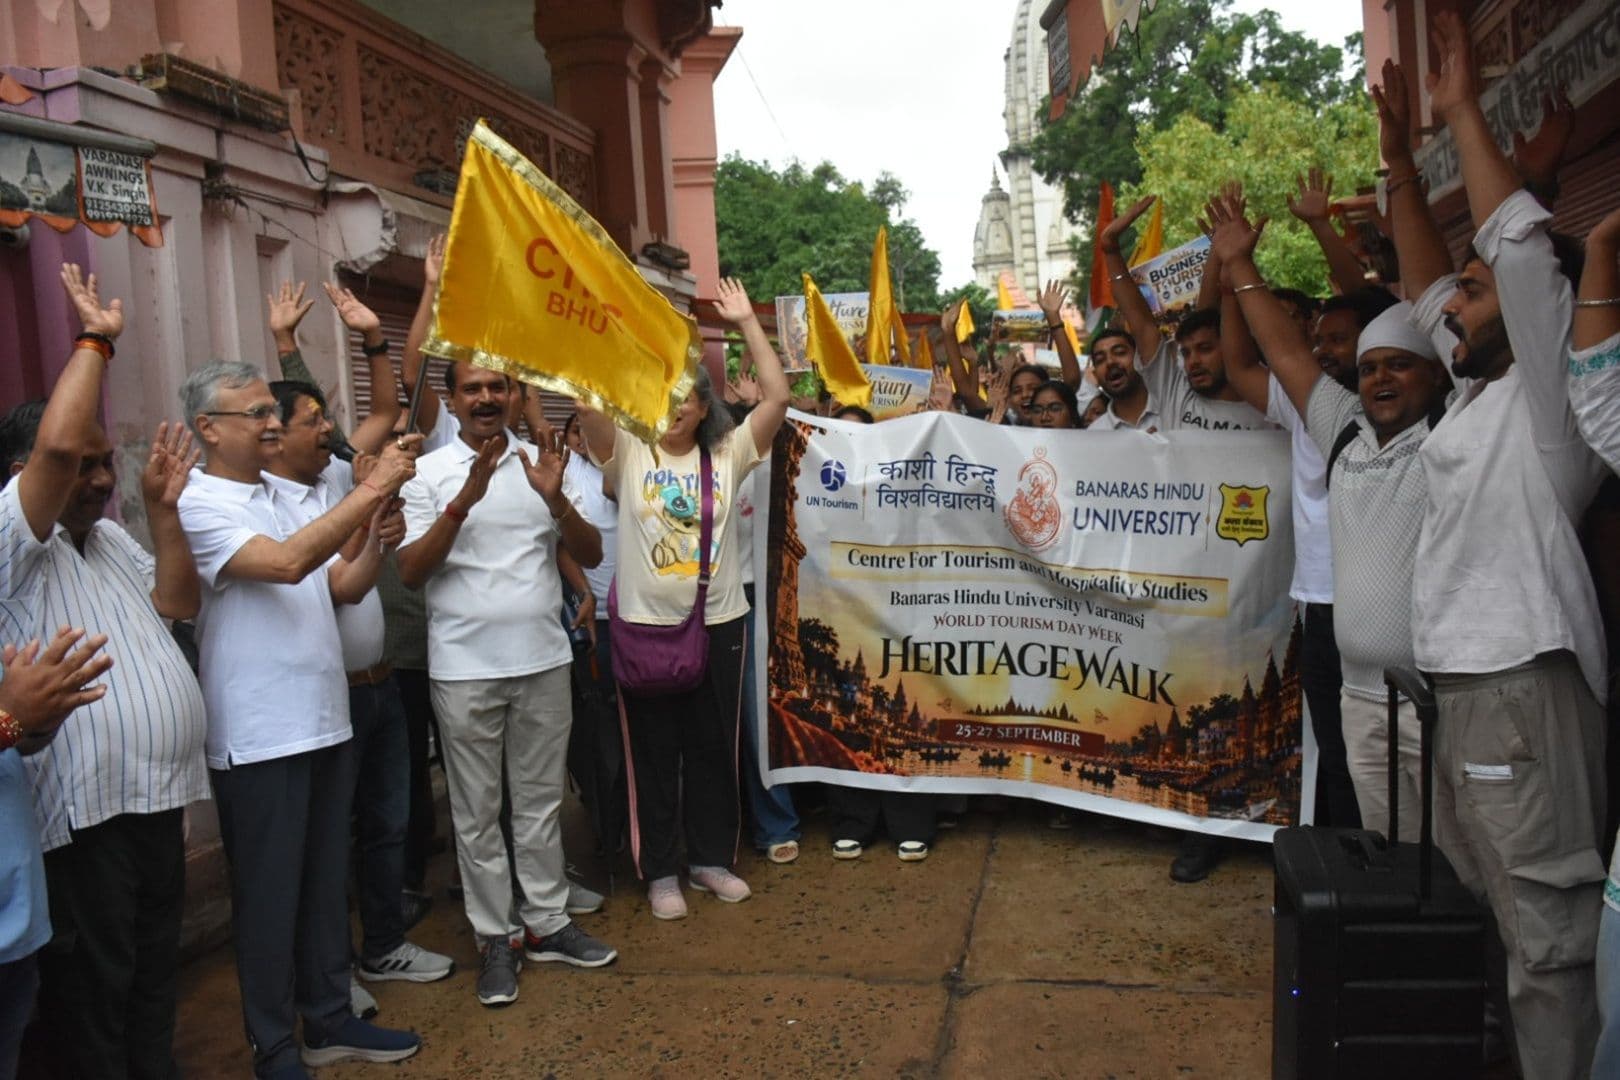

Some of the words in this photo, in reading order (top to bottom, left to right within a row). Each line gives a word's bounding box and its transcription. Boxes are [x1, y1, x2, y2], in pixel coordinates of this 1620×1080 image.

[83, 150, 143, 170] VARANASI
[85, 163, 144, 185] AWNINGS
[86, 178, 109, 196] V.K.
[112, 183, 146, 202] Singh
[1149, 248, 1210, 283] BUSINESS
[546, 292, 609, 336] BHU
[878, 451, 937, 481] काशी
[945, 454, 998, 496] हिन्दू
[806, 496, 820, 508] UN
[821, 497, 859, 510] Tourism
[876, 483, 998, 513] विश्वविद्यालय
[1075, 480, 1149, 500] BANARAS
[1153, 482, 1205, 501] HINDU
[1073, 507, 1201, 536] UNIVERSITY
[848, 548, 906, 569] Centre
[910, 551, 938, 569] For
[941, 550, 1016, 570] Tourism
[1019, 559, 1046, 579] and
[1046, 569, 1138, 601] Hospitality
[1140, 578, 1209, 603] Studies
[890, 590, 950, 606] Banaras
[954, 589, 1001, 605] Hindu
[1005, 590, 1083, 617] University
[1085, 600, 1145, 629] Varanasi
[933, 611, 986, 630] WORLD
[988, 614, 1054, 631] TOURISM
[1057, 619, 1086, 637] DAY
[1088, 622, 1124, 645] WEEK
[878, 634, 1070, 680] HERITAGE
[1074, 645, 1177, 707] WALK
[955, 722, 993, 738] 25-27
[996, 725, 1081, 748] SEPTEMBER
